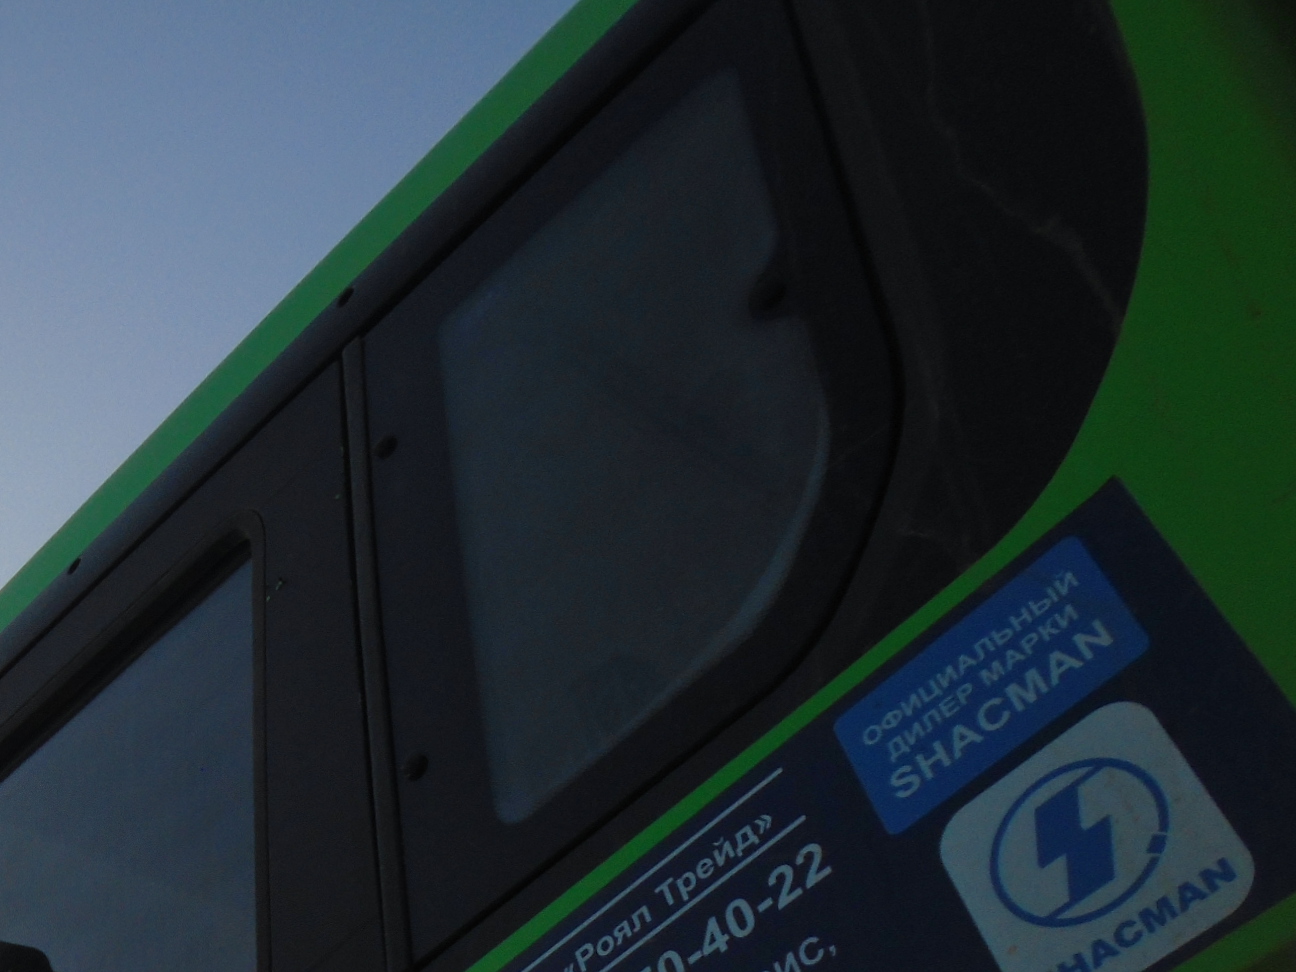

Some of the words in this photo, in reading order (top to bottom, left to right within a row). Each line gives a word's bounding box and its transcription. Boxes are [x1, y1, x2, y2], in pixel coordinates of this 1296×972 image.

[861, 570, 1080, 747] ОФИЦИАЛЬНЫЙ
[886, 683, 974, 764] ДИЛЕР
[980, 604, 1080, 685] МАРКИ
[889, 620, 1114, 799] SHACMAN
[654, 813, 773, 906] Трейд»
